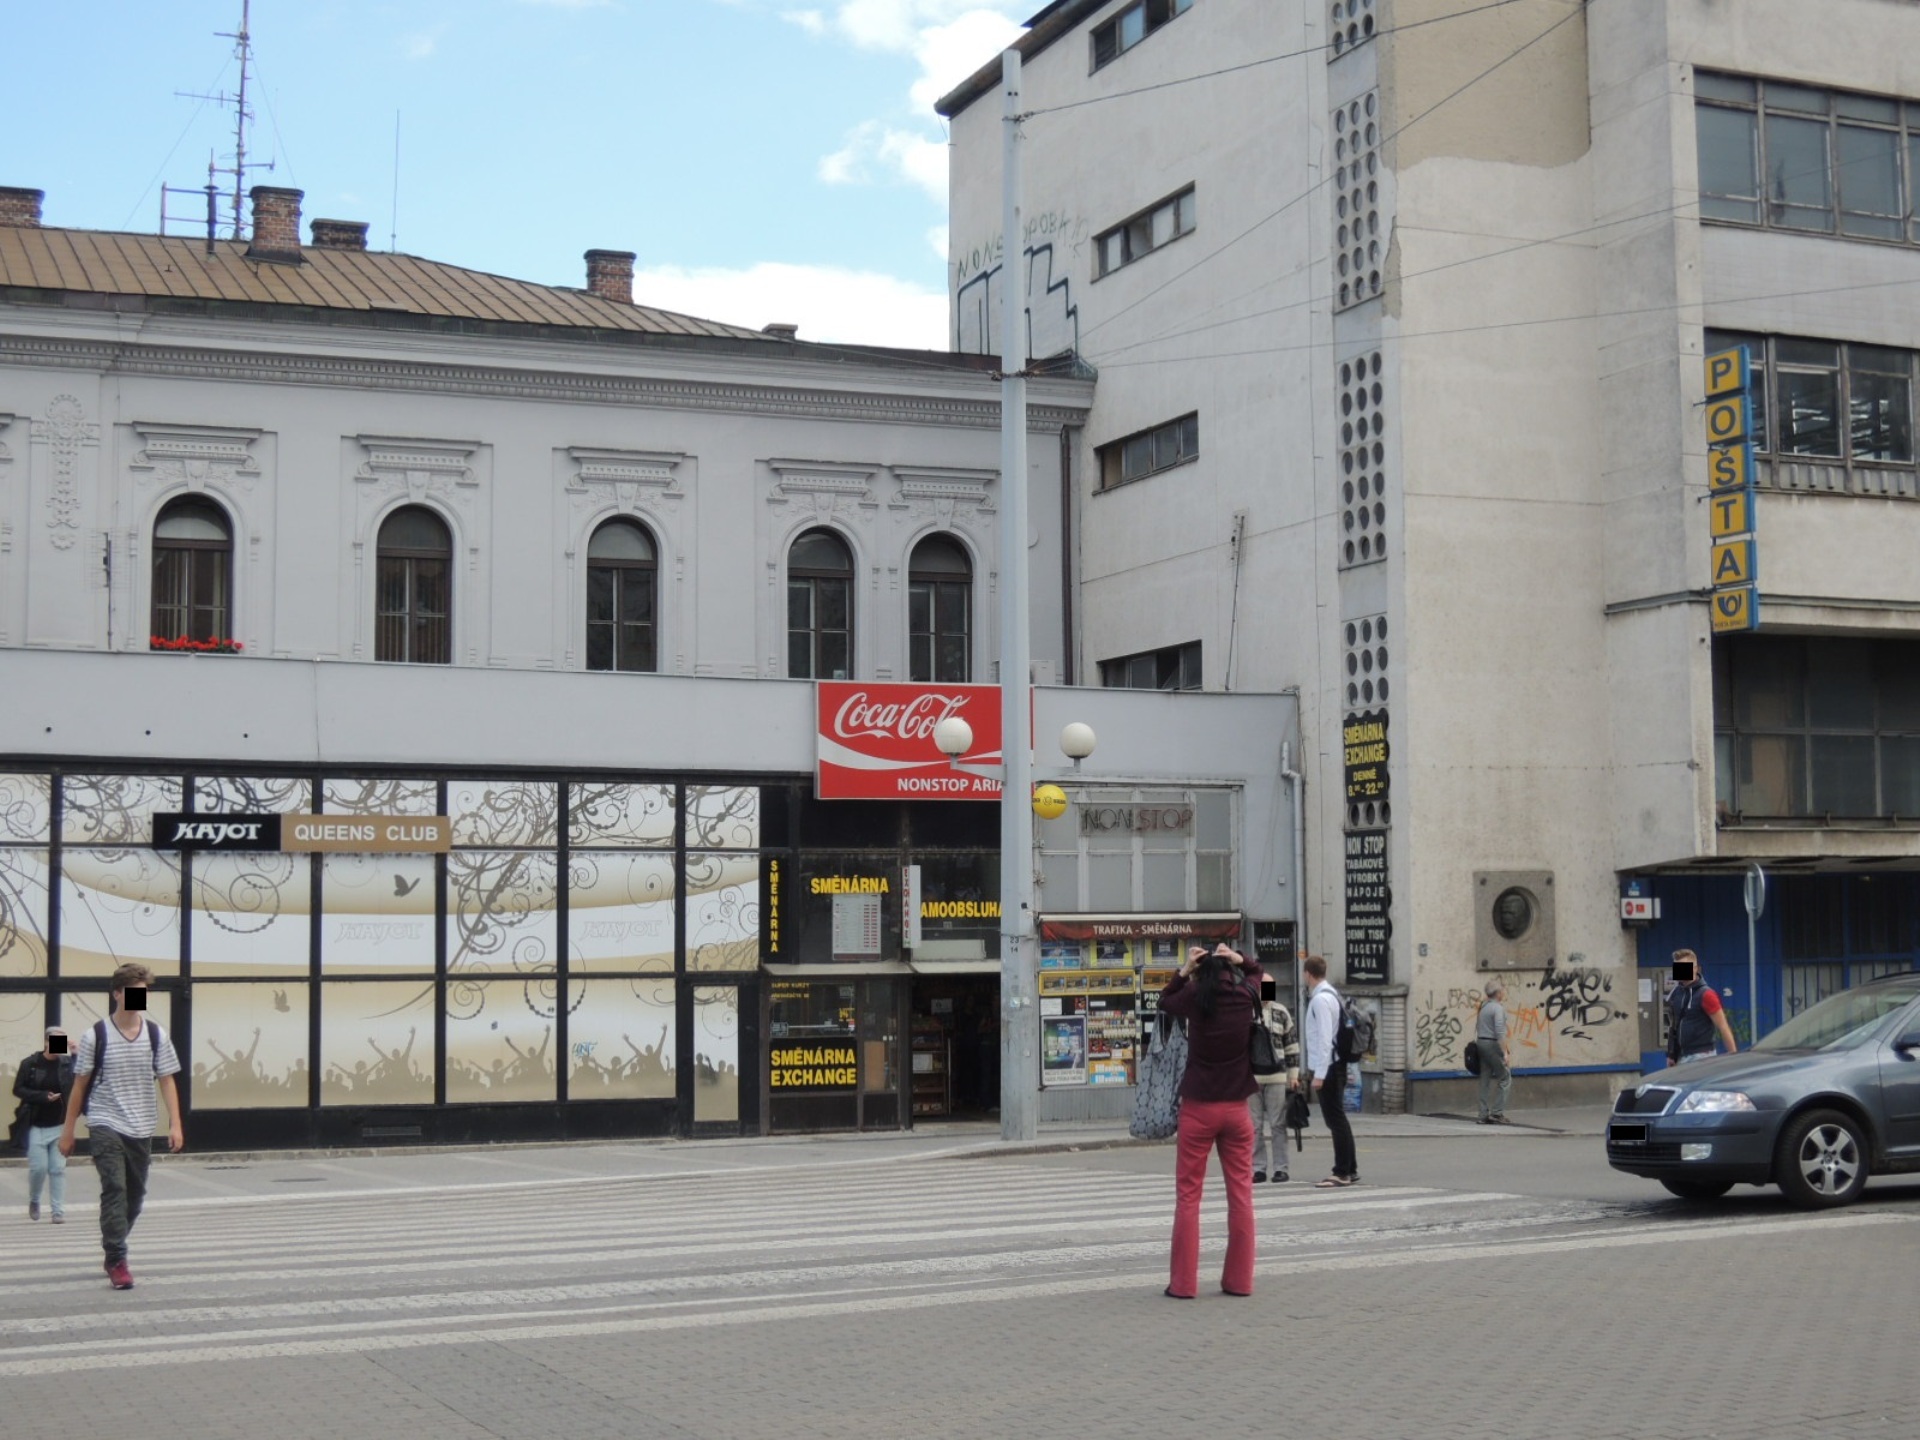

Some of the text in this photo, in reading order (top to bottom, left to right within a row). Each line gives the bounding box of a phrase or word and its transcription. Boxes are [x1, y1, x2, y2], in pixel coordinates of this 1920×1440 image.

[1711, 357, 1741, 580] POŠTA
[834, 692, 971, 739] Coca-Col
[1344, 722, 1384, 746] SMĚNÁRNA
[1345, 743, 1385, 766] EXCHANGE
[897, 779, 968, 792] NONSTOP
[172, 823, 261, 844] KAJOT
[295, 825, 438, 841] QUEENS CLUB
[1347, 836, 1384, 854] NON STOP
[811, 875, 889, 894] SMĚNÁRNA
[1347, 872, 1385, 883] VÝROBKY
[1347, 885, 1385, 898] NÁPOJE
[921, 901, 1002, 918] AMOOBSLUH
[1093, 925, 1133, 935] TRAFIKA
[1141, 922, 1192, 935] SMĚNÁRNA
[1368, 930, 1384, 940] TISK
[1010, 936, 1019, 944] 23
[1349, 943, 1384, 954] BAGETY
[1354, 956, 1377, 968] KÁVA
[771, 1046, 855, 1066] SMĚNÁRNA
[771, 1068, 856, 1086] EXCHANGE
